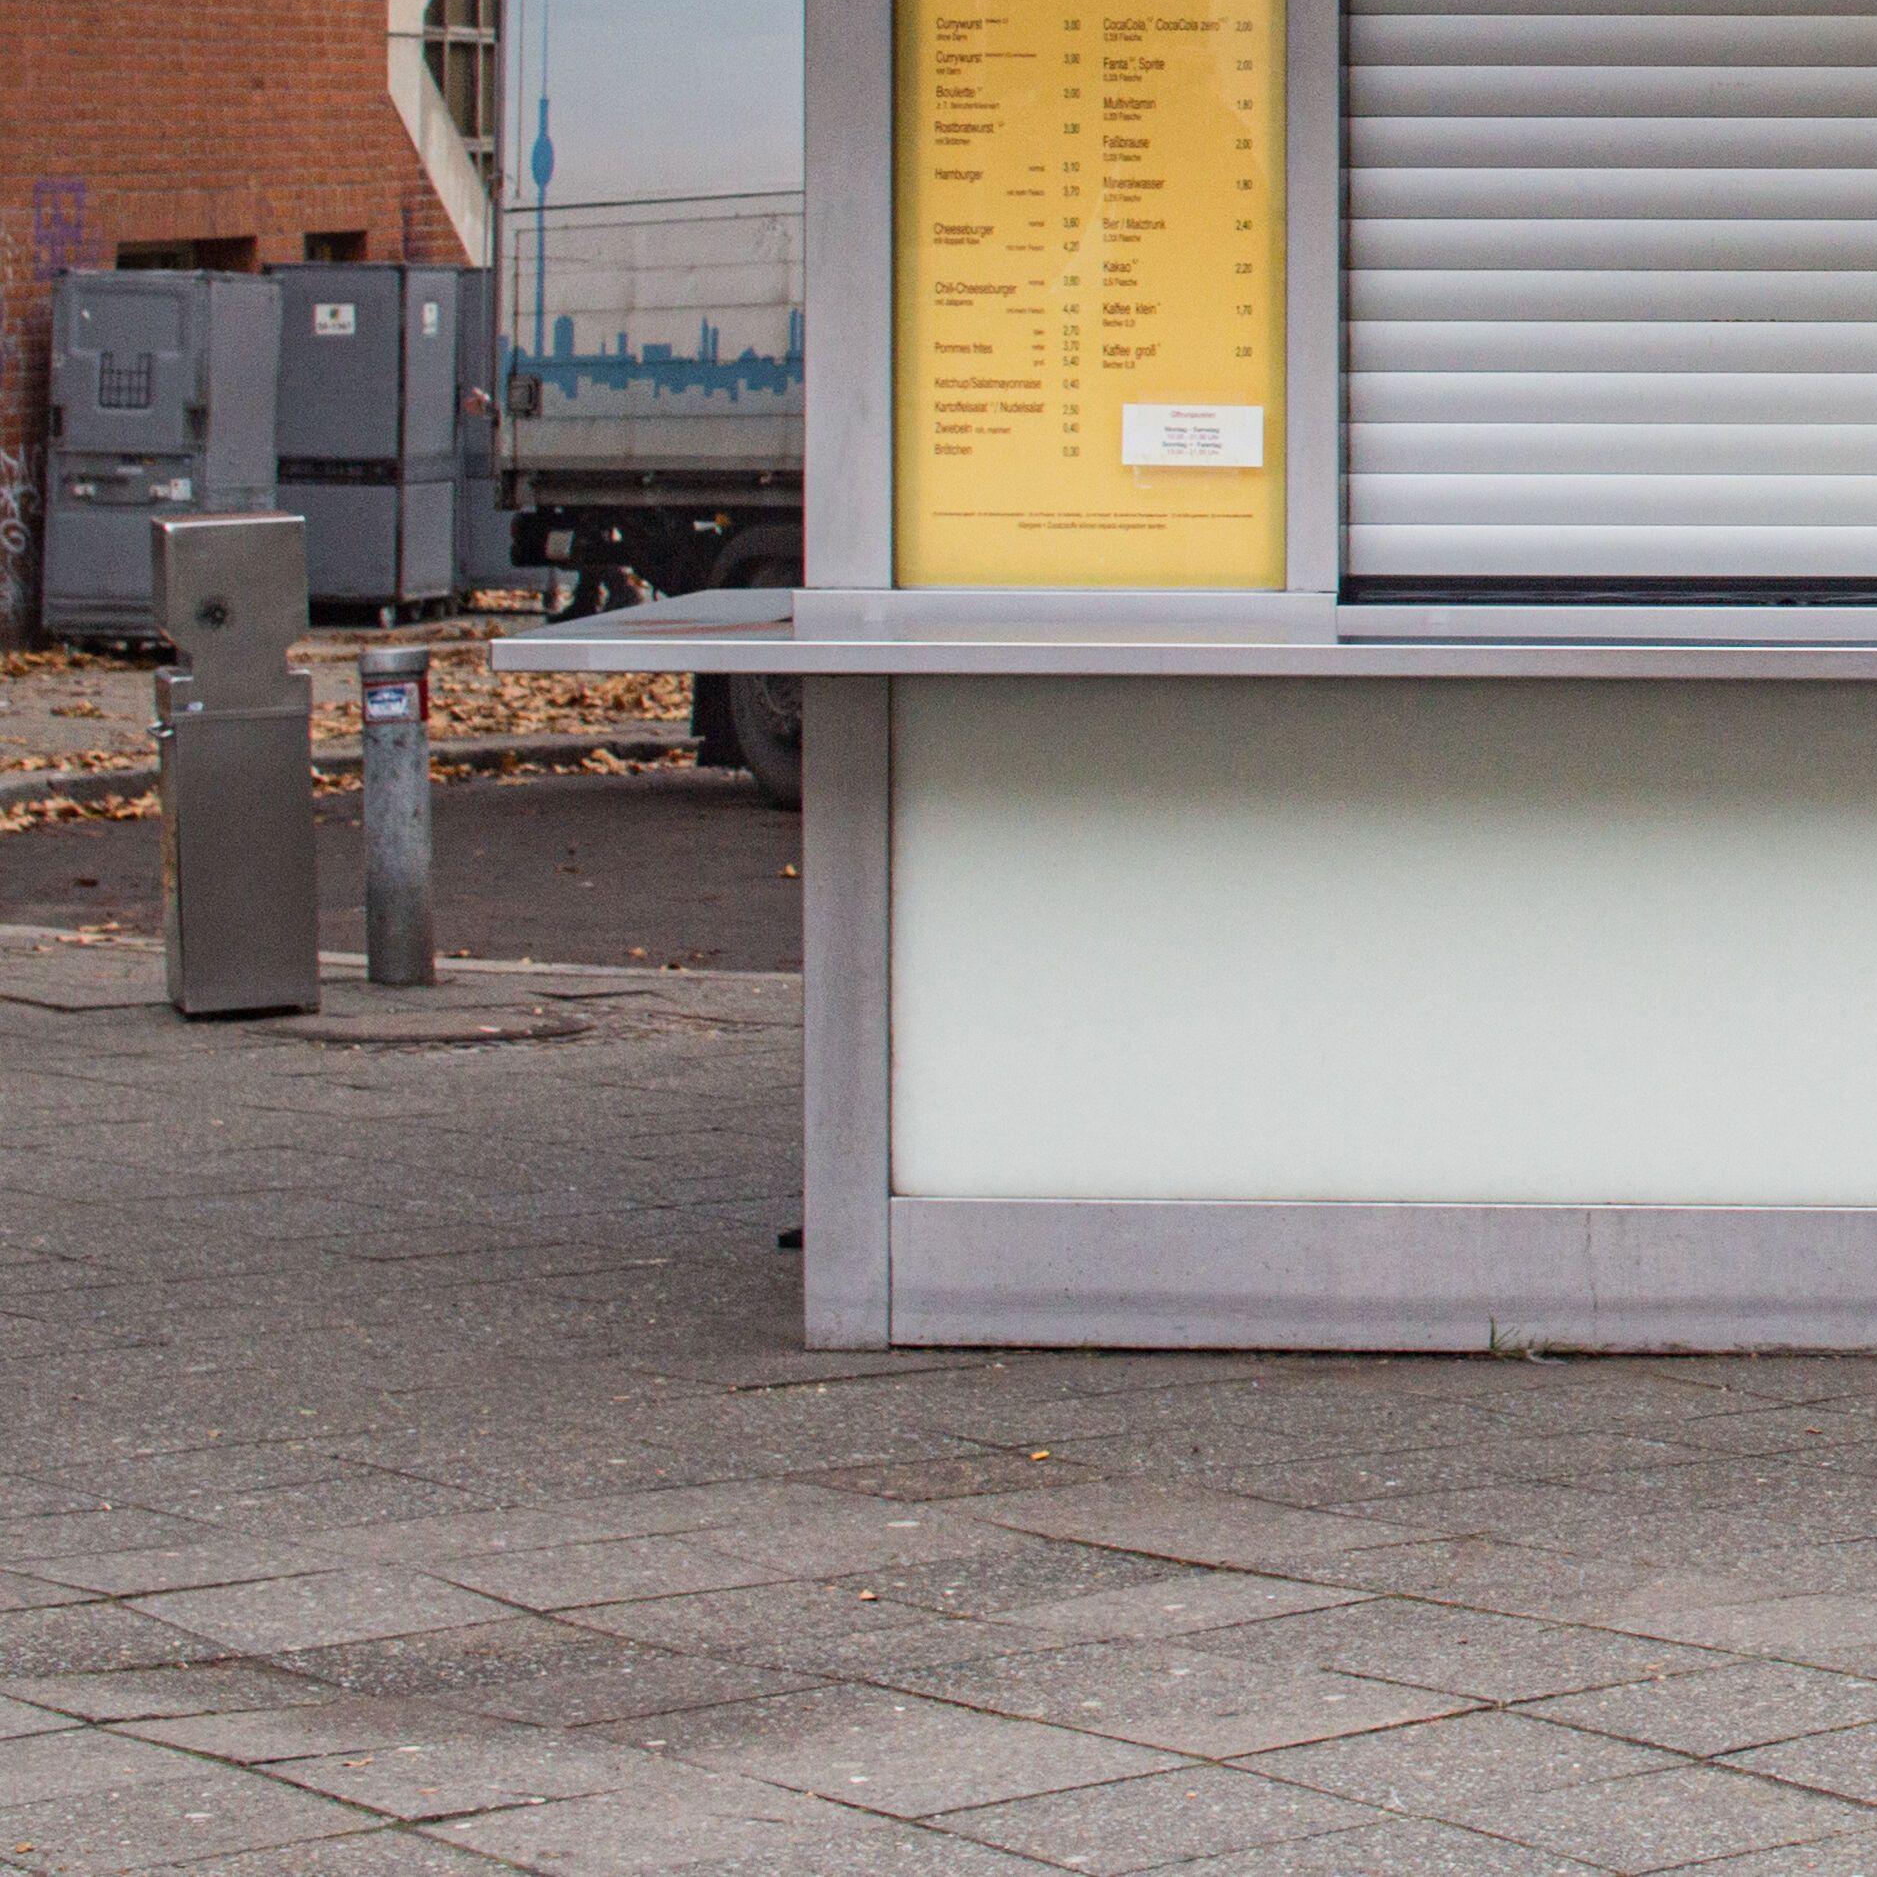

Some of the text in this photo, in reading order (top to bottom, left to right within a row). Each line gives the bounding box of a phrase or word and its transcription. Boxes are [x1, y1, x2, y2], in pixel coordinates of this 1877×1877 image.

[936, 18, 982, 32] Currywurst
[936, 51, 982, 65] Currywurst
[1139, 58, 1165, 72] Sprite
[934, 169, 983, 182] Hamburger
[934, 223, 994, 237] Cheeseburger
[1104, 261, 1131, 273] Kakao
[935, 282, 1017, 298] Chili-Cheeseburger
[1103, 303, 1131, 314] Kaffee
[1136, 303, 1156, 314] klein
[935, 342, 971, 354] Pommes
[1103, 344, 1131, 357] Kaffee
[1000, 402, 1044, 413] Nudelsalat
[934, 444, 973, 455] Brötchen
